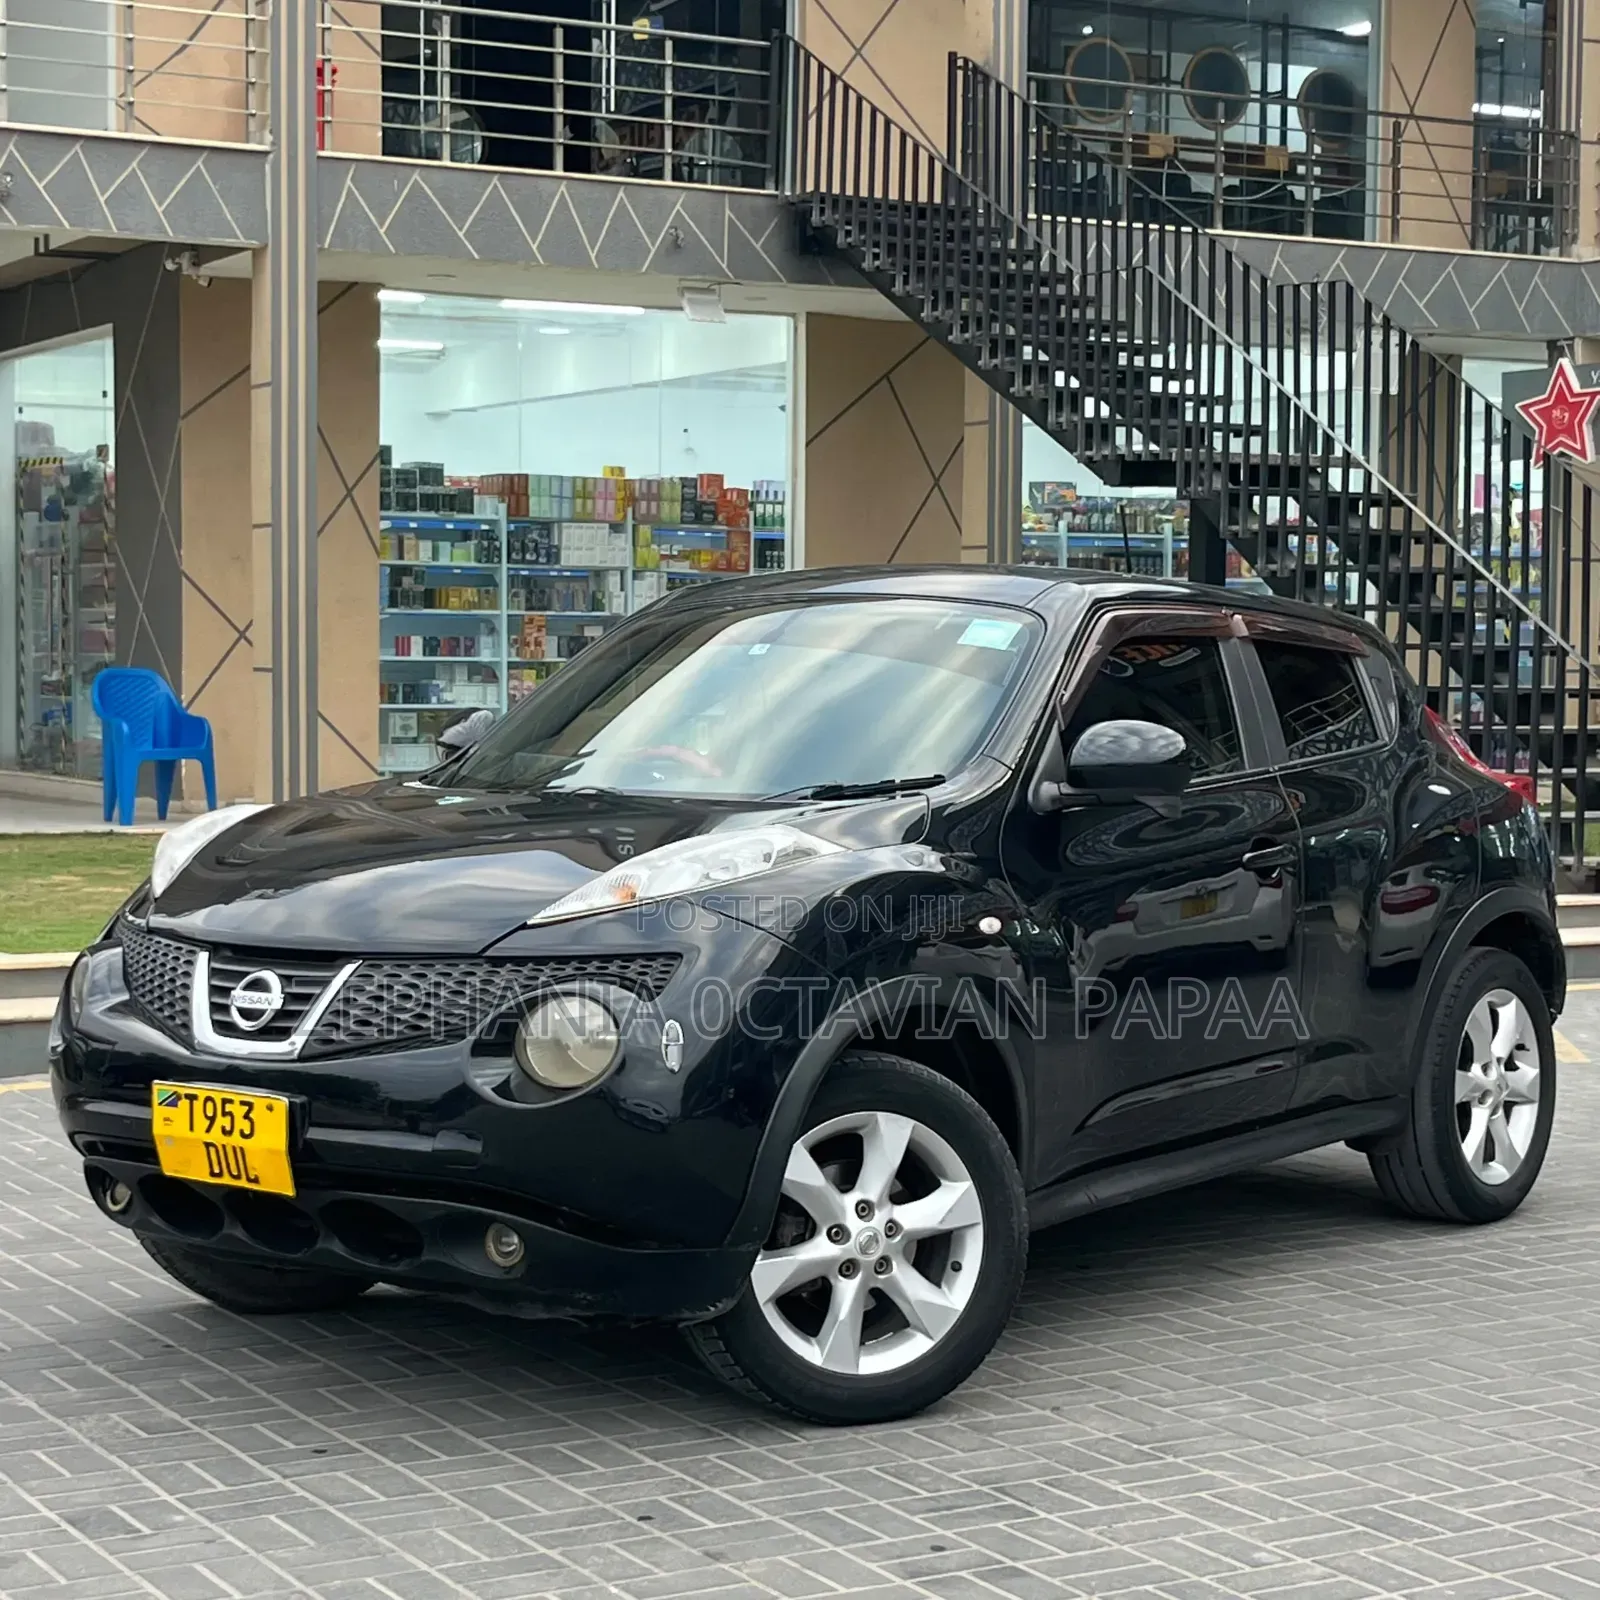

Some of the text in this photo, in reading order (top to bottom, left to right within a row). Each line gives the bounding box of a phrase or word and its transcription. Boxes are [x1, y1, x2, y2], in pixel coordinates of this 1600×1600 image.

[231, 994, 274, 1006] NISSAN
[184, 1093, 255, 1139] T953
[203, 1141, 260, 1184] DUL
